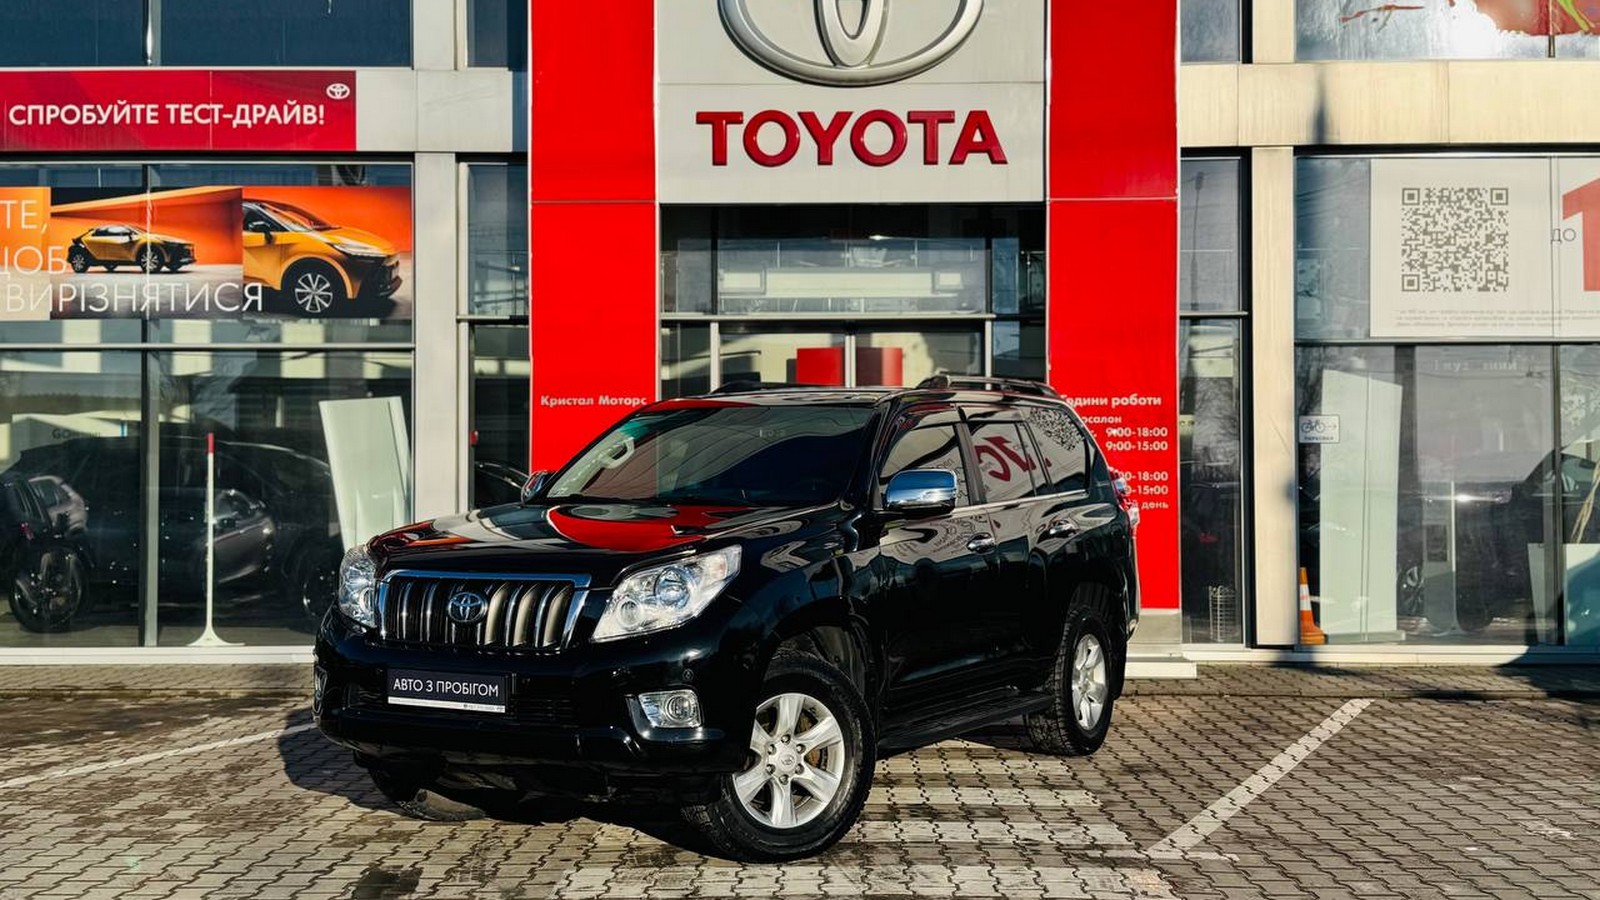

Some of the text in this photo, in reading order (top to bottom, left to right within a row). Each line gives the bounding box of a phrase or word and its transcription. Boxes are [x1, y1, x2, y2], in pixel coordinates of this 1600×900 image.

[9, 100, 325, 128] СПРОБУЙТЕ ТЕСТ-ДРАЙВ!
[696, 109, 1008, 167] TOYOTA
[6, 282, 262, 313] ВИРІЗНЯТИСЯ
[540, 395, 648, 408] Кристал Моторс
[1111, 393, 1162, 408] роботи
[1105, 427, 1168, 438] 9:00-18:00
[1105, 441, 1168, 452] 9:00-15:00
[393, 677, 424, 692] АВТО
[436, 680, 499, 698] ПРОБІГОМ
